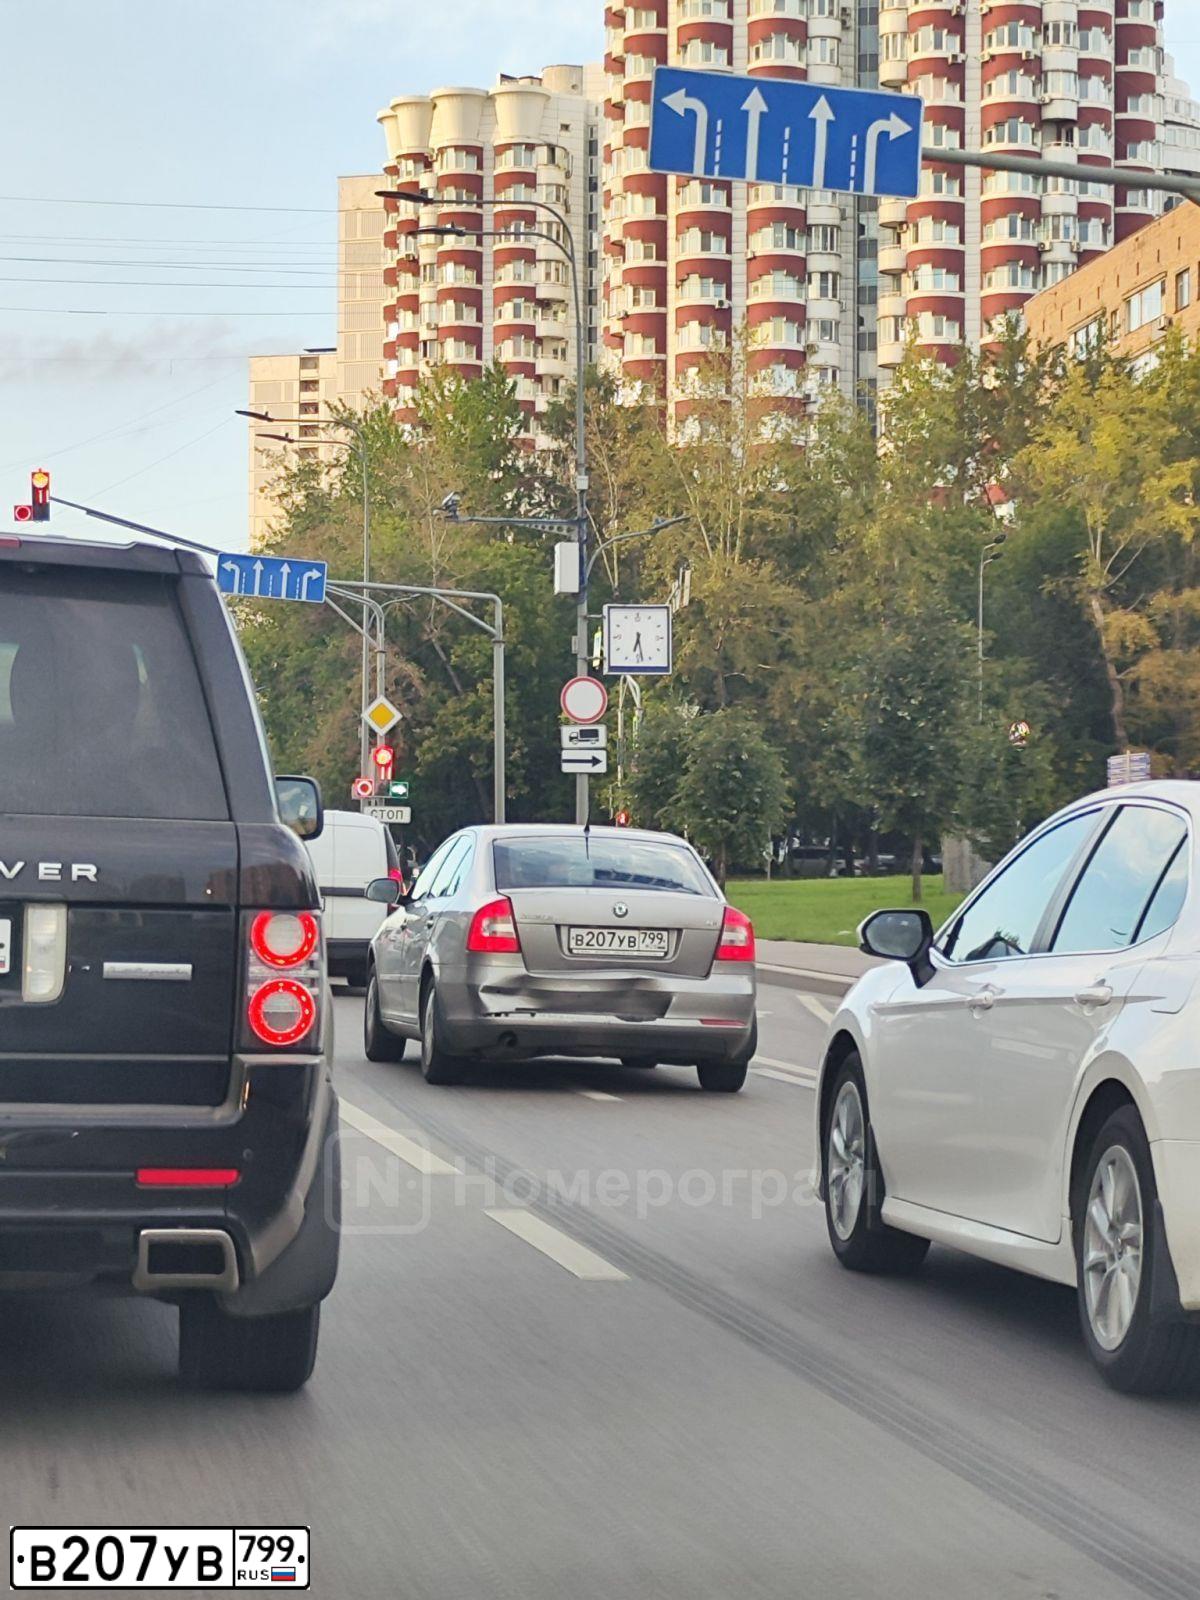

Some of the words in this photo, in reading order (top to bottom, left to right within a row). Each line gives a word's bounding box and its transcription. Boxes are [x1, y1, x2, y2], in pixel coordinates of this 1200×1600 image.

[371, 809, 404, 820] СТОП
[575, 931, 637, 948] В207УВ
[641, 932, 664, 945] 799
